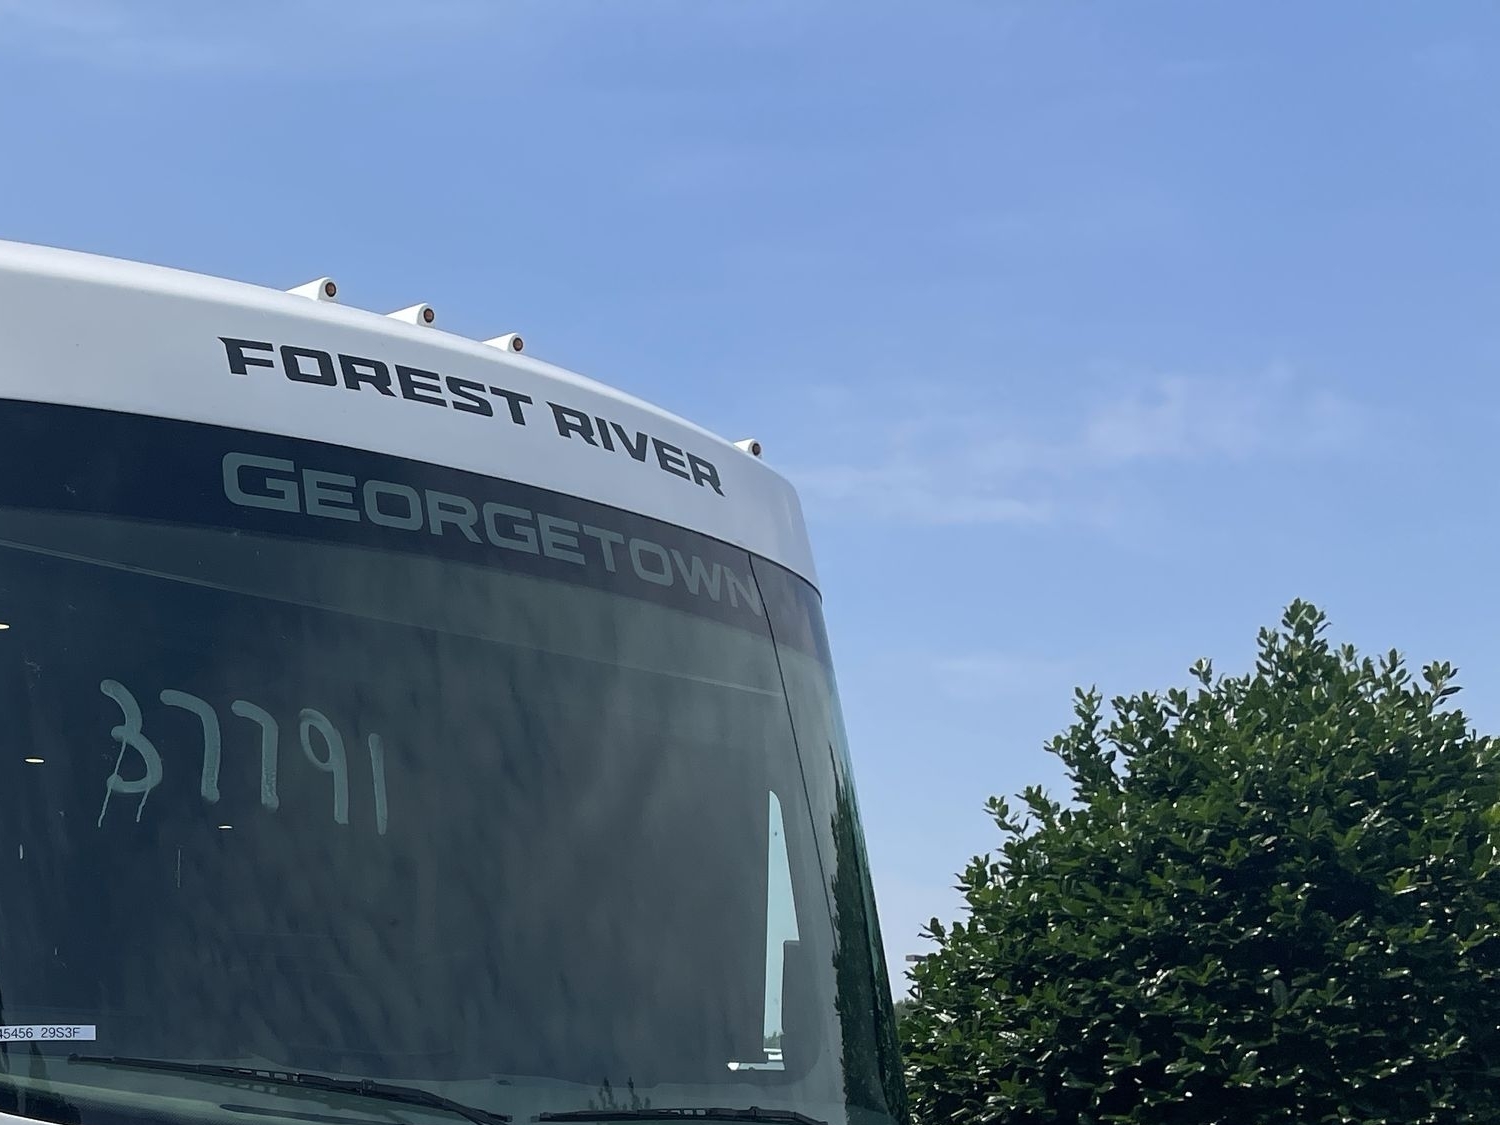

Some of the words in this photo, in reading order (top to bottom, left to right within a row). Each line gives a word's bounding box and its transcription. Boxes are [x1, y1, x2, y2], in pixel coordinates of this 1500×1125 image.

[217, 336, 532, 426] FOREST
[546, 401, 725, 496] RIVER
[222, 452, 762, 616] GEORGETOWN
[99, 679, 388, 834] 37791
[41, 1026, 81, 1039] 29S3F
